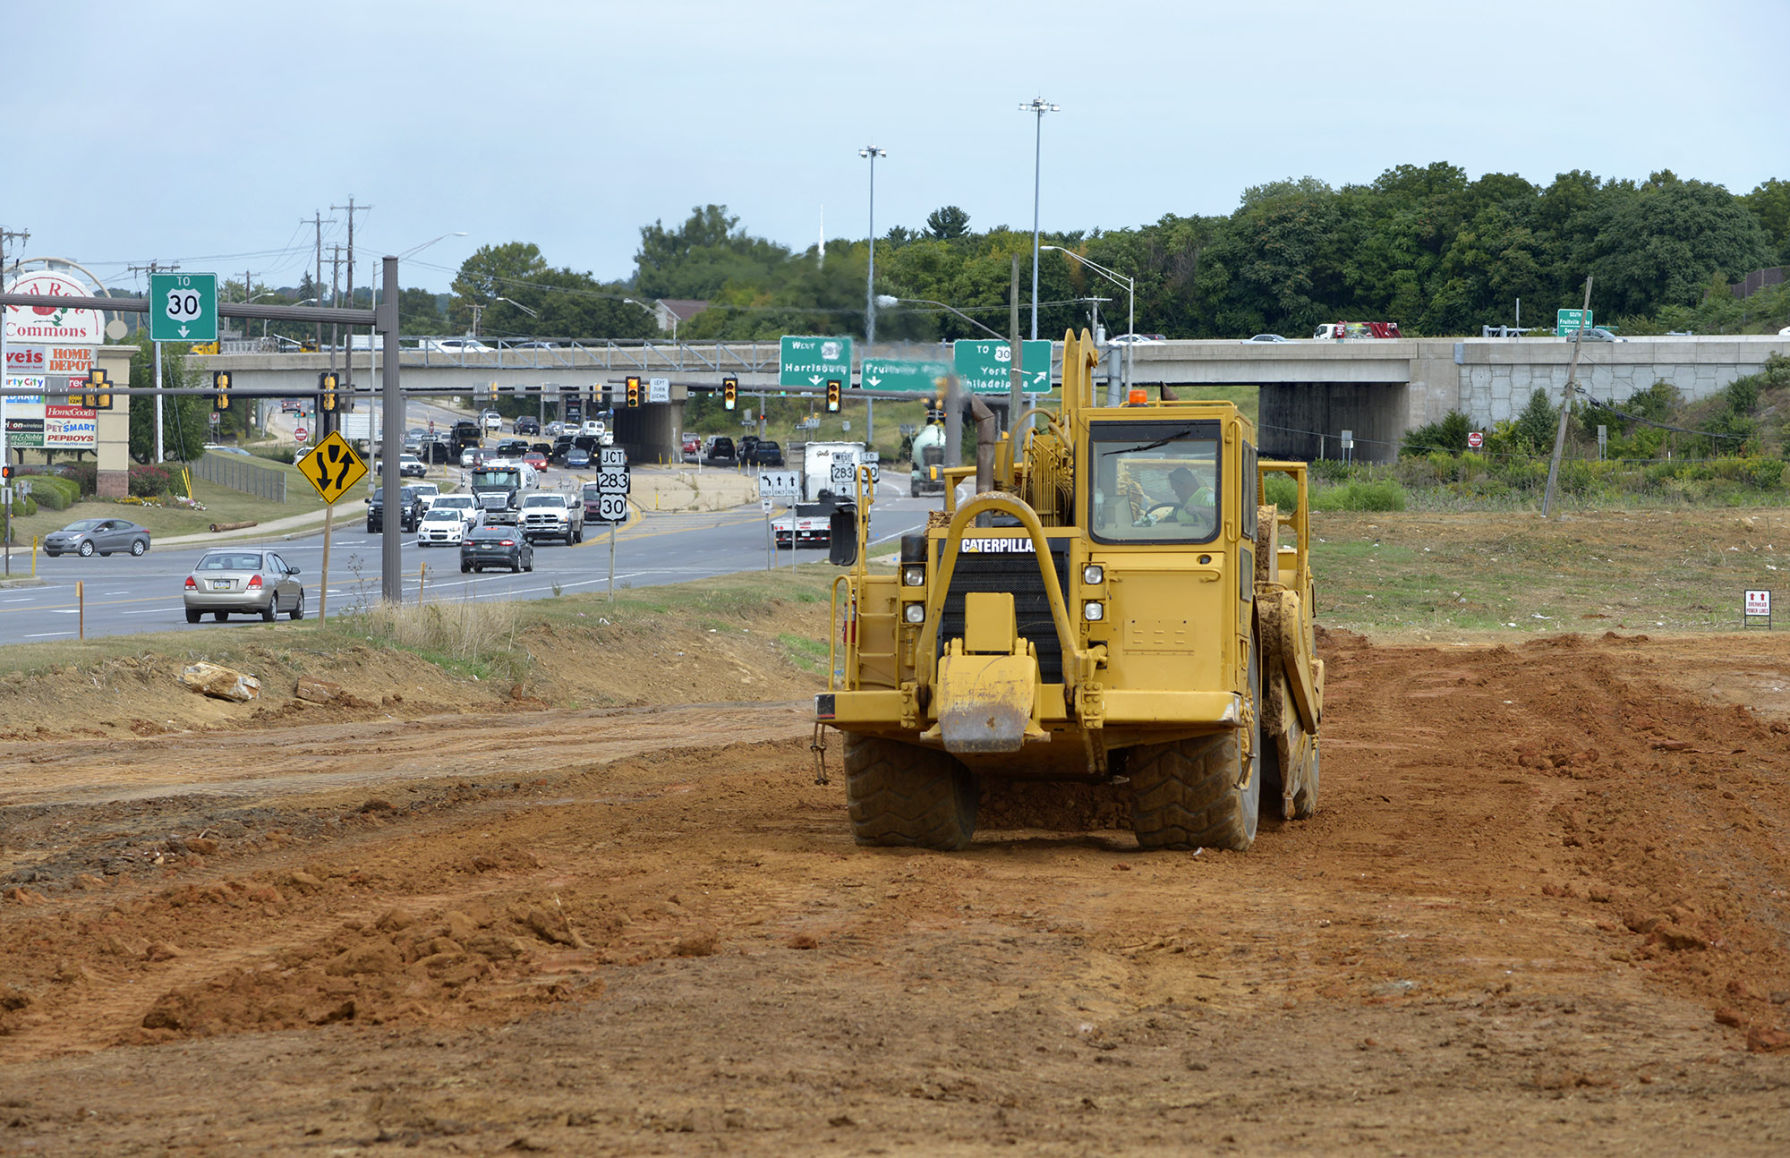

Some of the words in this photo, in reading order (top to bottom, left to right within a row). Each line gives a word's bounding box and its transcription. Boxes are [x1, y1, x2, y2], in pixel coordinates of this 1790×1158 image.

[177, 276, 191, 287] TO
[168, 294, 198, 315] 30
[6, 322, 87, 337] Commons
[53, 348, 92, 360] HOME
[976, 345, 990, 354] TO
[997, 350, 1010, 359] 30
[49, 360, 95, 372] DEPOT
[981, 366, 1007, 375] York
[24, 378, 44, 387] City
[966, 379, 1028, 391] hiladelpa
[47, 407, 95, 416] HomeGoods
[46, 423, 95, 432] PETSMART
[602, 451, 623, 463] JCT
[834, 467, 853, 479] 283
[600, 473, 628, 488] 283
[602, 500, 624, 514] 30
[961, 539, 1037, 553] CATERPILLA
